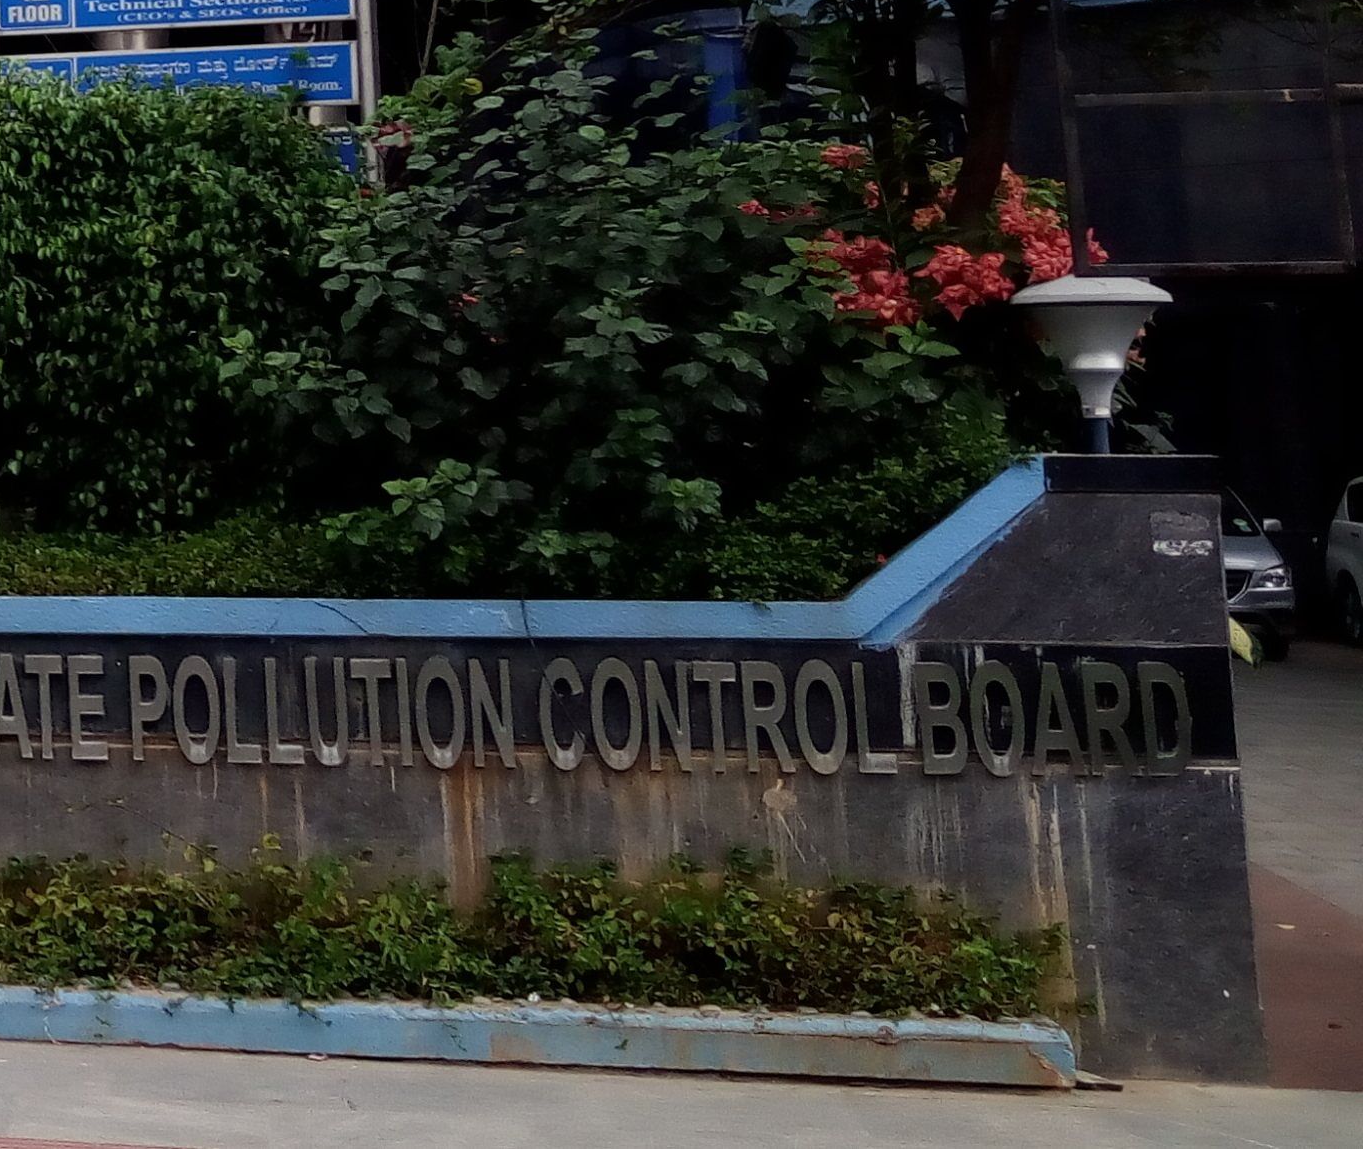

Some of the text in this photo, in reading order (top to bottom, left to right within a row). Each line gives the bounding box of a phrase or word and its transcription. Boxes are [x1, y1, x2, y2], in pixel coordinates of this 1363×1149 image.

[8, 4, 63, 24] FLOOR
[179, 10, 193, 19] &
[128, 654, 516, 770] POLLUTION
[539, 656, 898, 776] CONTROL
[914, 660, 1193, 778] BOARD
